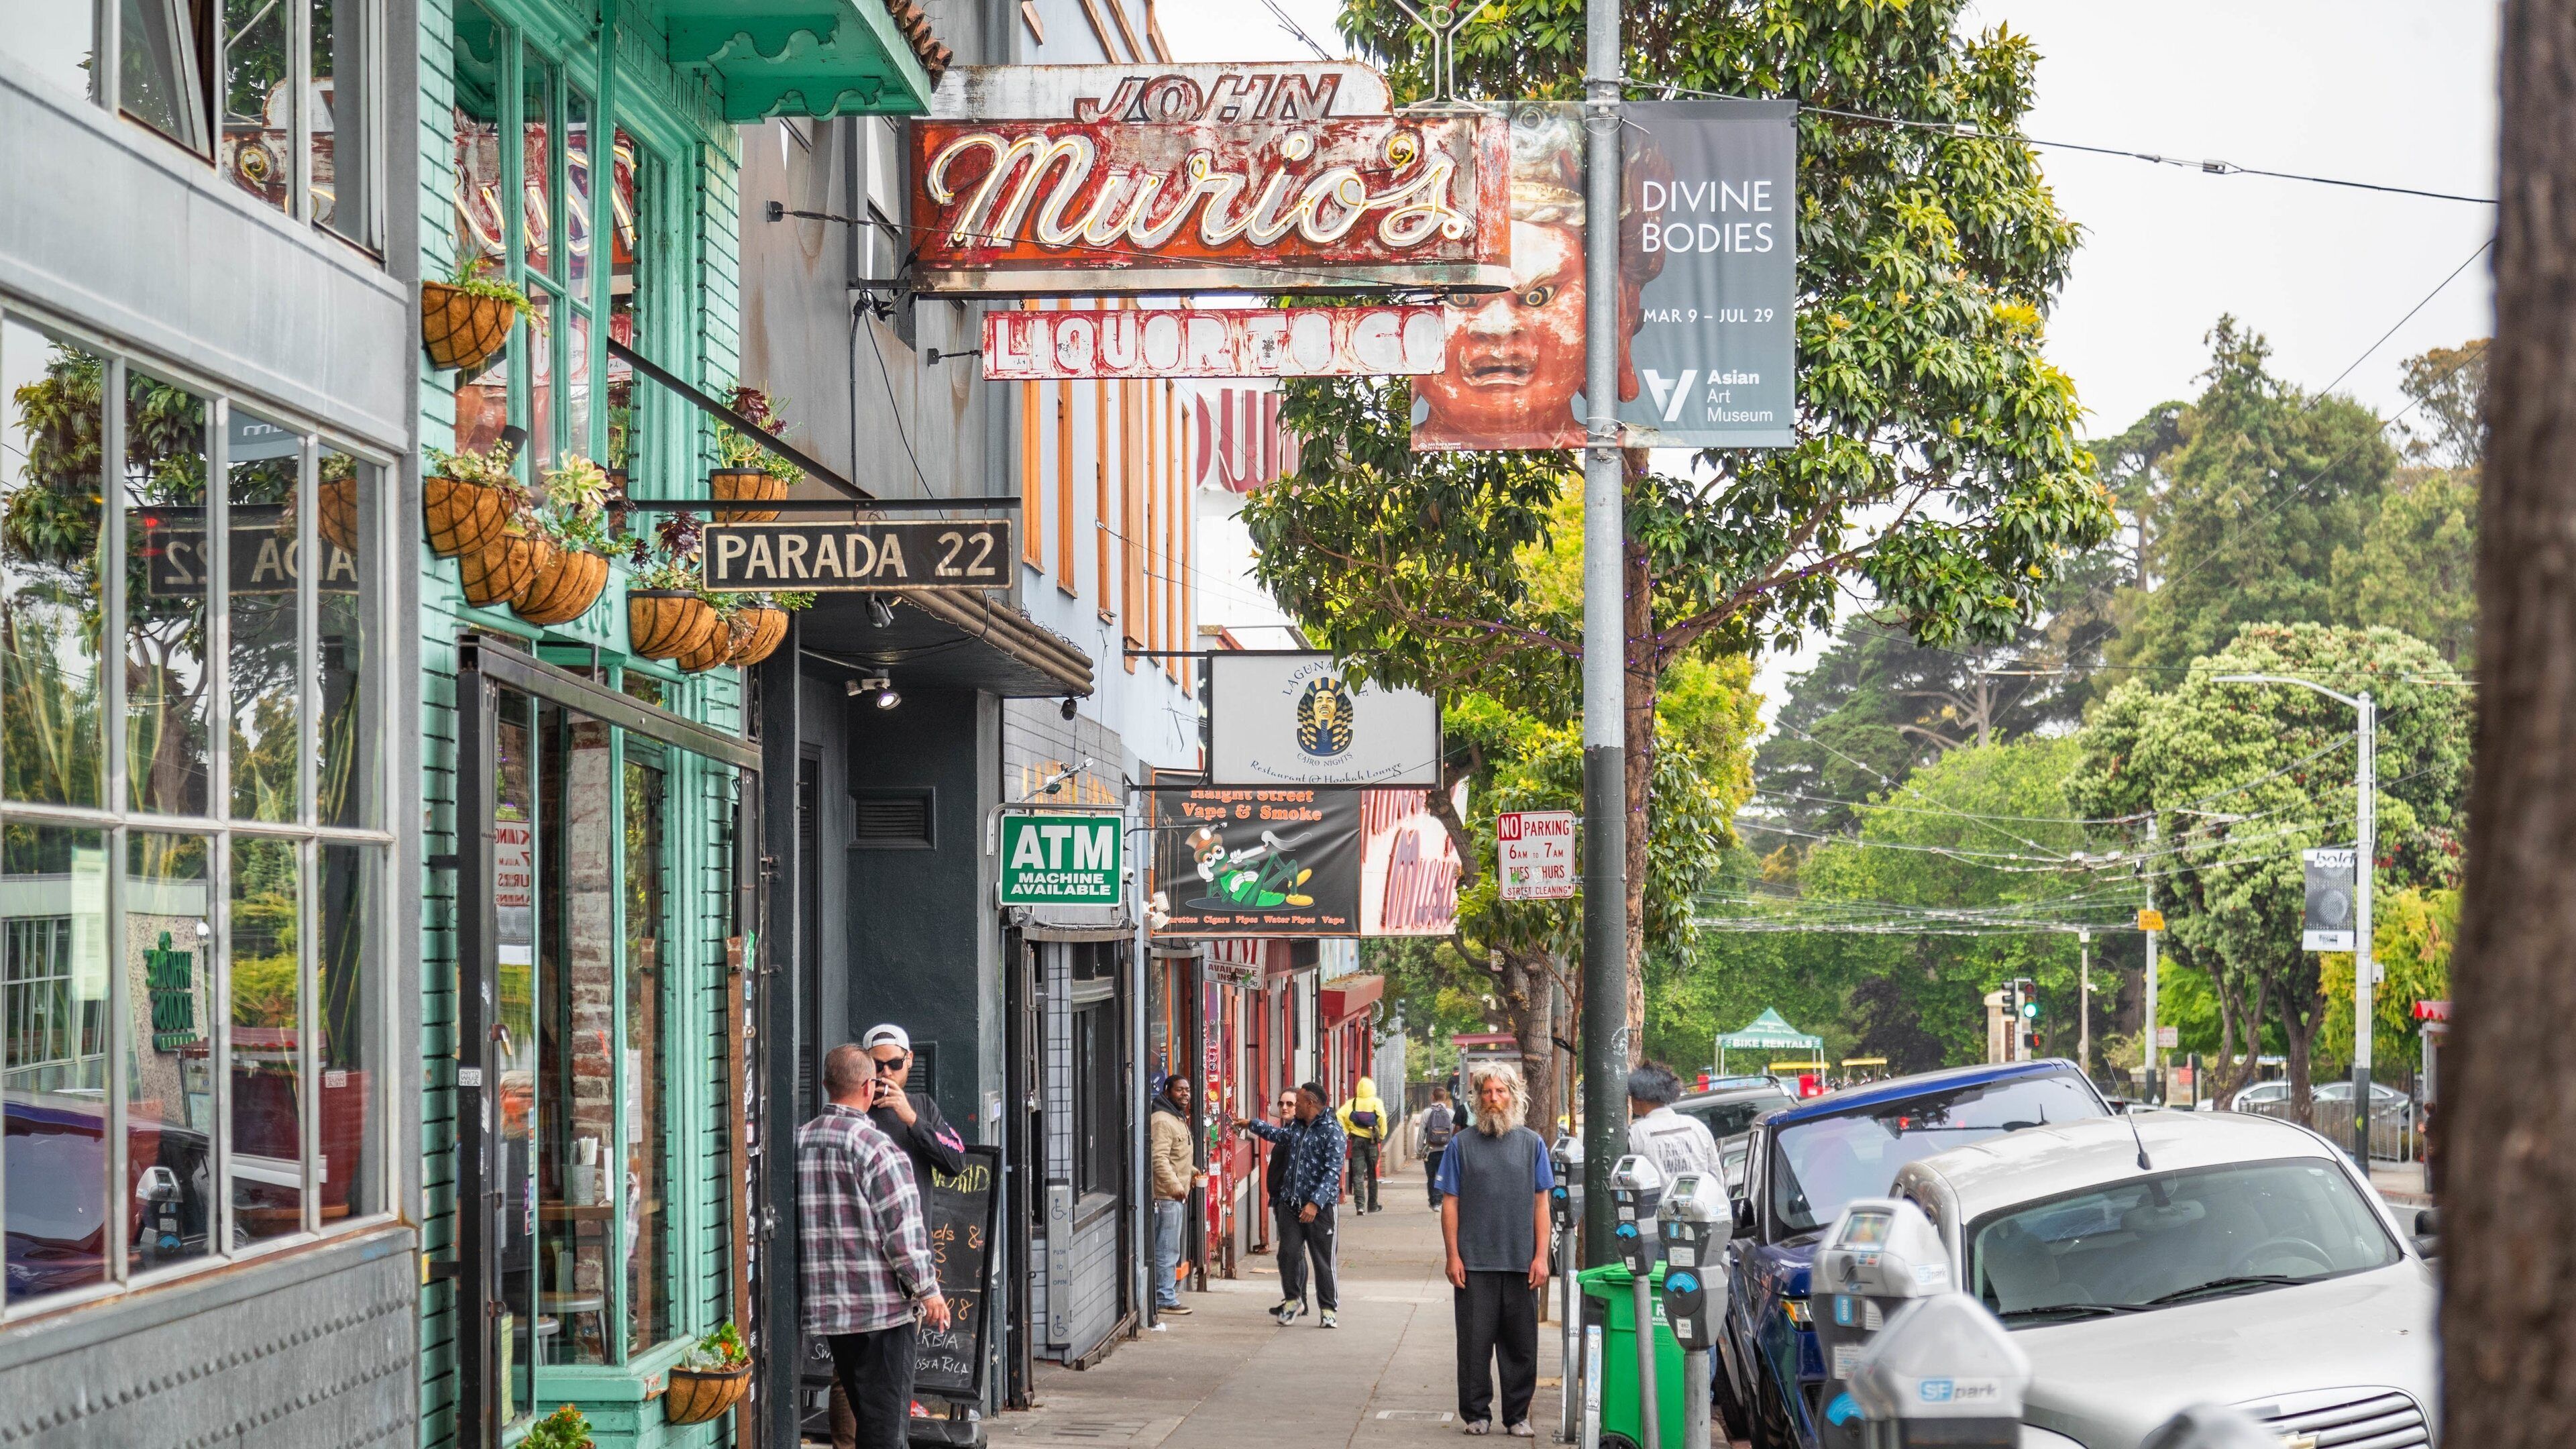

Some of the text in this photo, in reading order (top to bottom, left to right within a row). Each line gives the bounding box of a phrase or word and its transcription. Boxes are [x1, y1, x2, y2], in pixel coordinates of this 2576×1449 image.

[1075, 74, 1342, 122] JOHN
[929, 132, 1474, 248] Murio's
[1642, 180, 1773, 212] DIVINE
[1642, 223, 1773, 253] BODIES
[1644, 309, 1682, 323] MAR
[1688, 309, 1698, 323] 9
[1719, 309, 1748, 323] JUL
[1754, 309, 1774, 323] 29
[994, 312, 1442, 372] LIQUOR TO GO
[1707, 370, 1760, 384] Asian
[1707, 388, 1731, 403] Art
[1707, 407, 1773, 422] Museum
[717, 532, 995, 580] PARADA 22
[1282, 661, 1334, 696] LAGUNA
[1297, 752, 1353, 767] CAIRO NIGHTS
[1250, 760, 1305, 783] Restaurant
[1324, 770, 1364, 783] Hookah
[1367, 762, 1403, 778] Lounge
[1256, 790, 1313, 802] Street
[1181, 802, 1322, 821] Vape & Smoke
[1501, 816, 1569, 839] NO PARKING
[1010, 825, 1113, 871] ATM
[1018, 873, 1104, 883] MACHINE
[1010, 884, 1111, 896] AVAILABLE
[1536, 886, 1567, 895] CLEANING
[1169, 916, 1198, 924] arettes
[1203, 916, 1230, 924] Cigars
[1236, 916, 1258, 924] Pipes
[1291, 916, 1316, 924] Pipes
[1322, 916, 1345, 924] Vape
[1733, 1039, 1813, 1048] BIKE RENTALS
